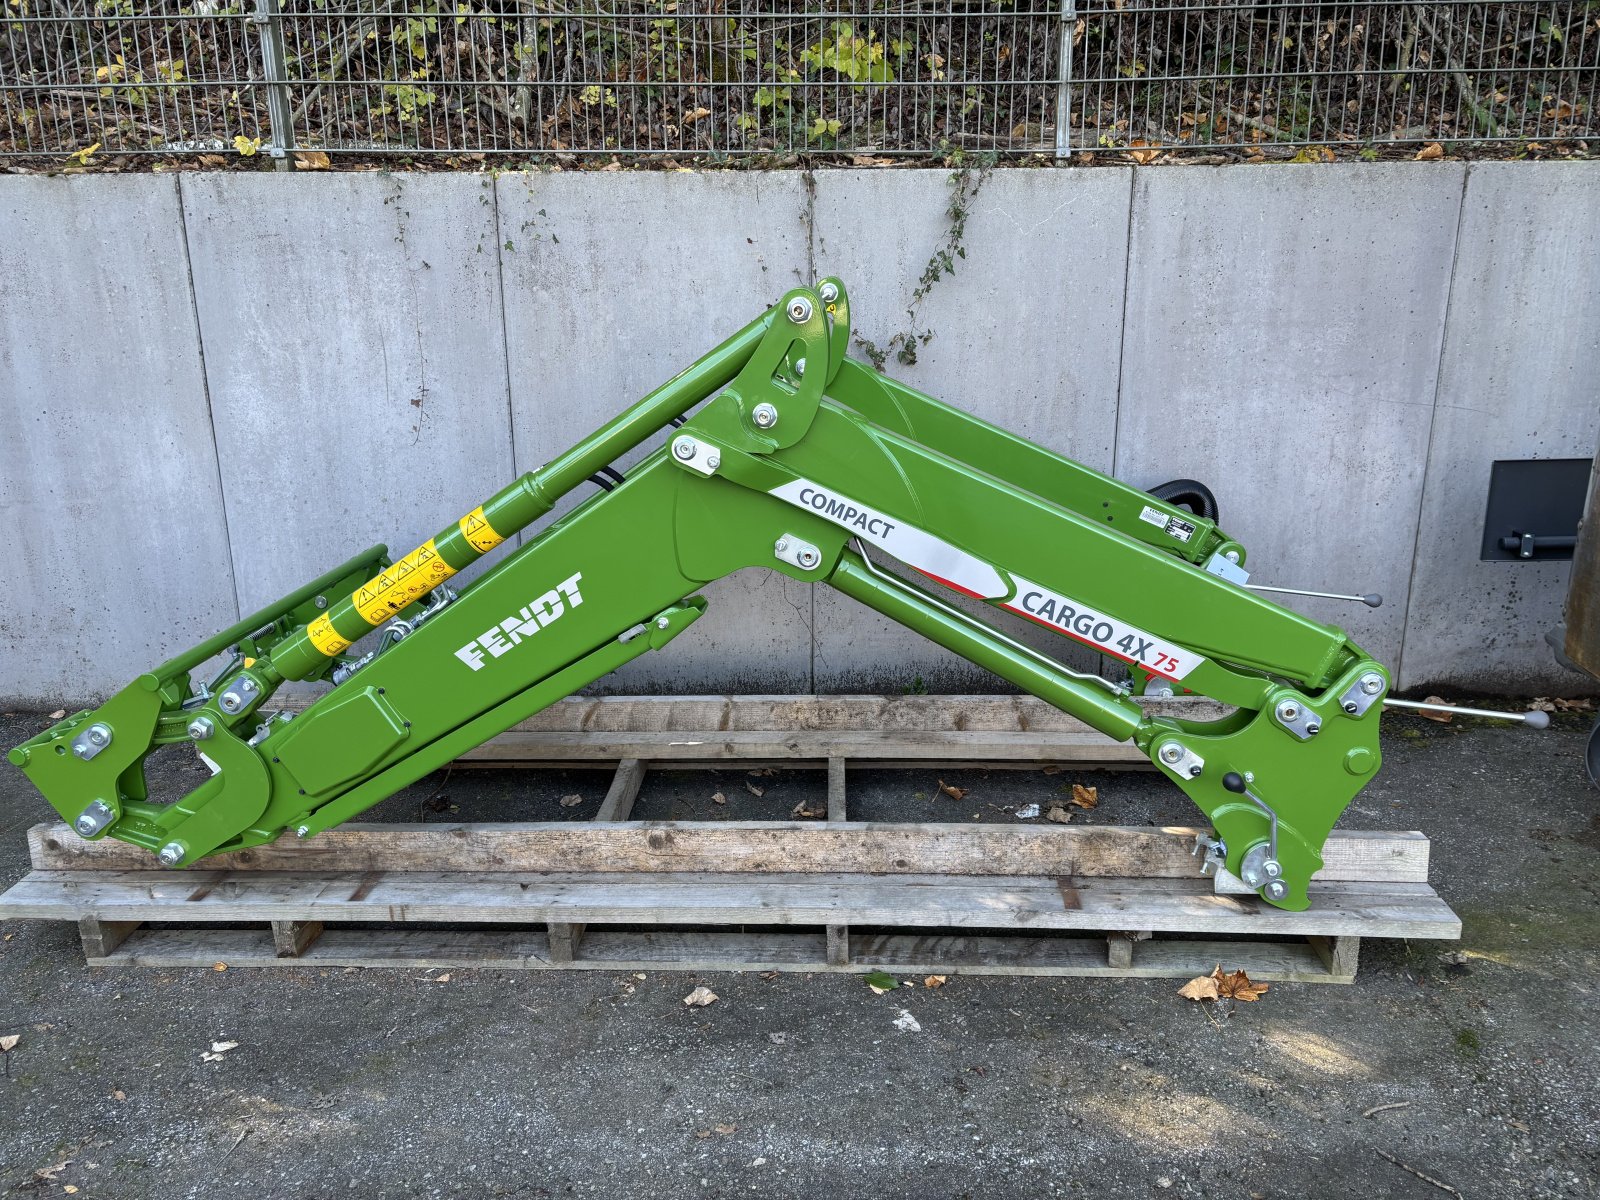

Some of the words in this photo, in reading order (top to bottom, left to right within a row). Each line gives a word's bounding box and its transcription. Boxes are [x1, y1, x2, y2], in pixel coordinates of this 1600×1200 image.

[799, 488, 896, 539] COMPACT
[453, 571, 584, 672] FENDT
[1022, 591, 1114, 643] CARGO
[1116, 634, 1154, 662] 4X
[1152, 652, 1180, 673] 75
